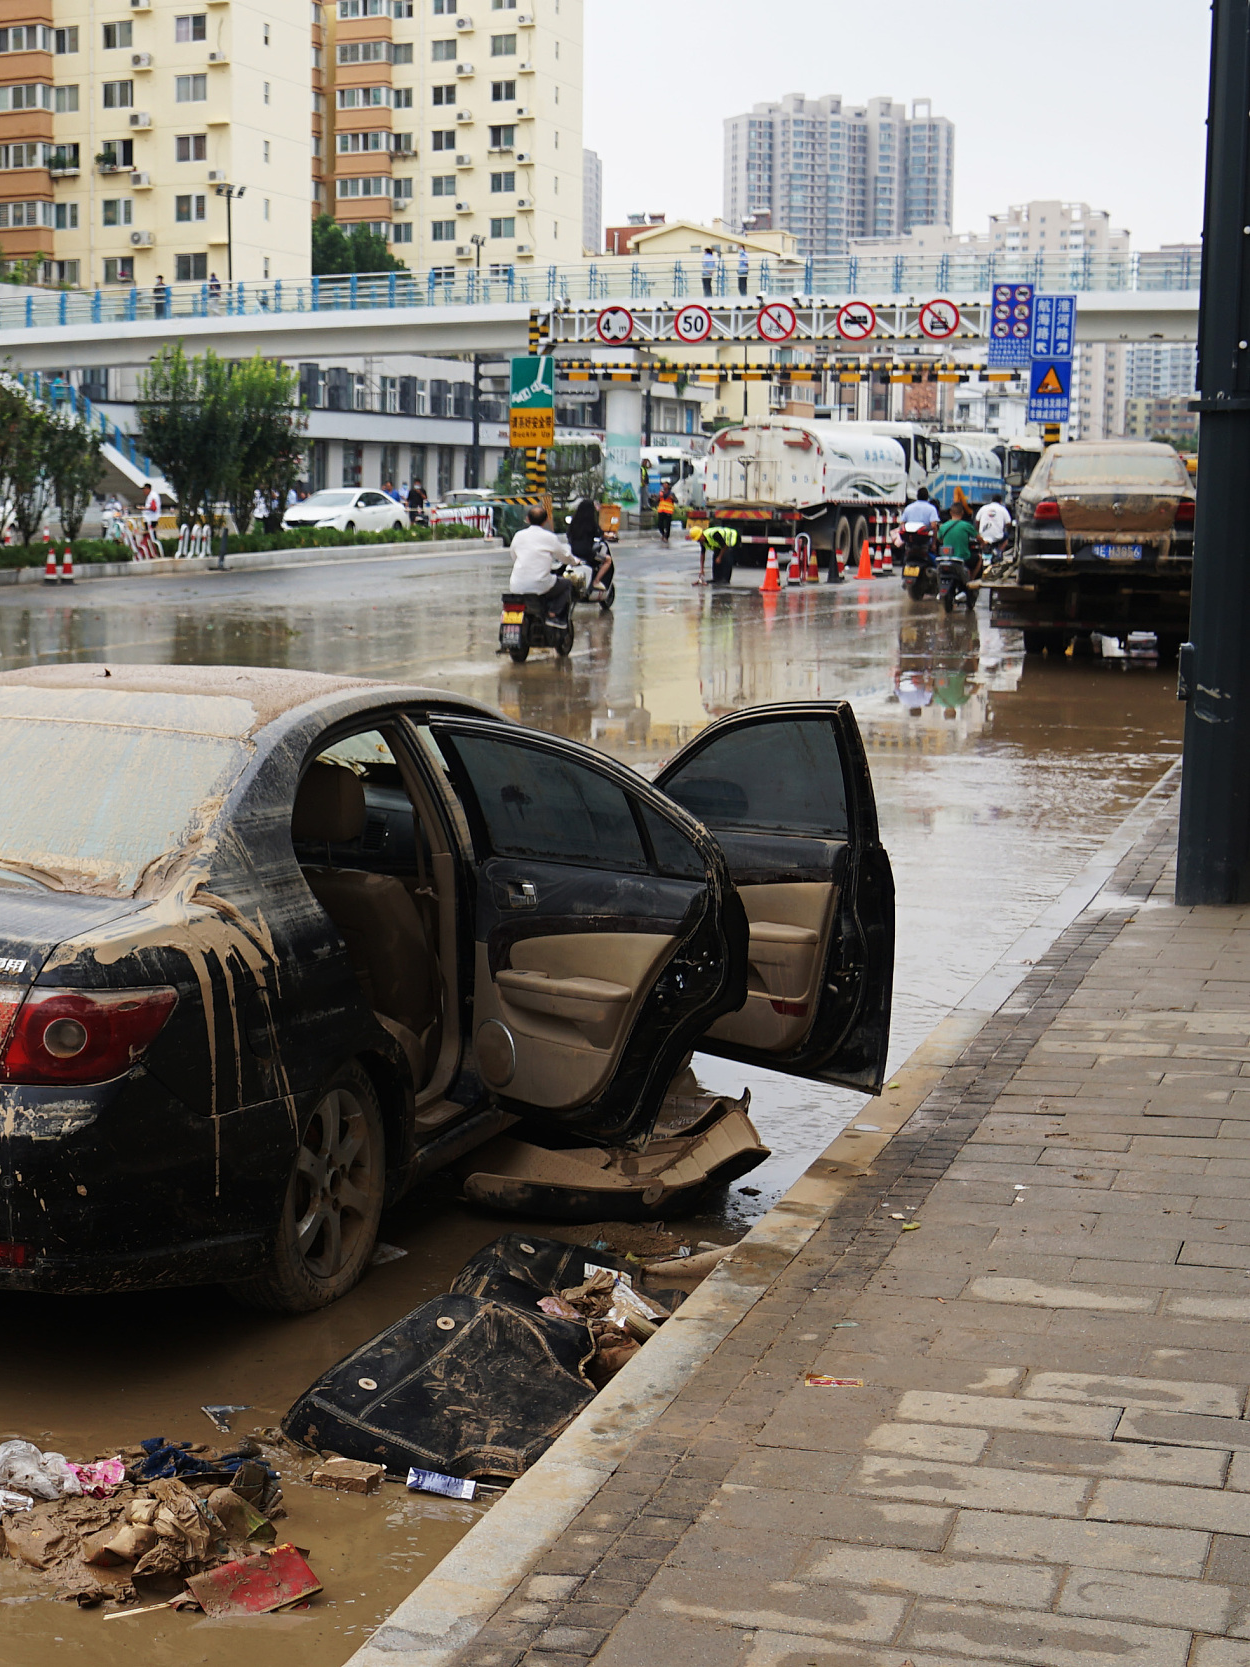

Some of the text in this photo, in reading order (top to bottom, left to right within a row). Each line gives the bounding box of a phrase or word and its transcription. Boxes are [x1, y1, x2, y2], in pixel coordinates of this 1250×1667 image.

[602, 318, 627, 333] 4 m
[683, 315, 704, 333] 50
[1036, 299, 1051, 340] 航海路
[1056, 299, 1071, 340] 淮河路
